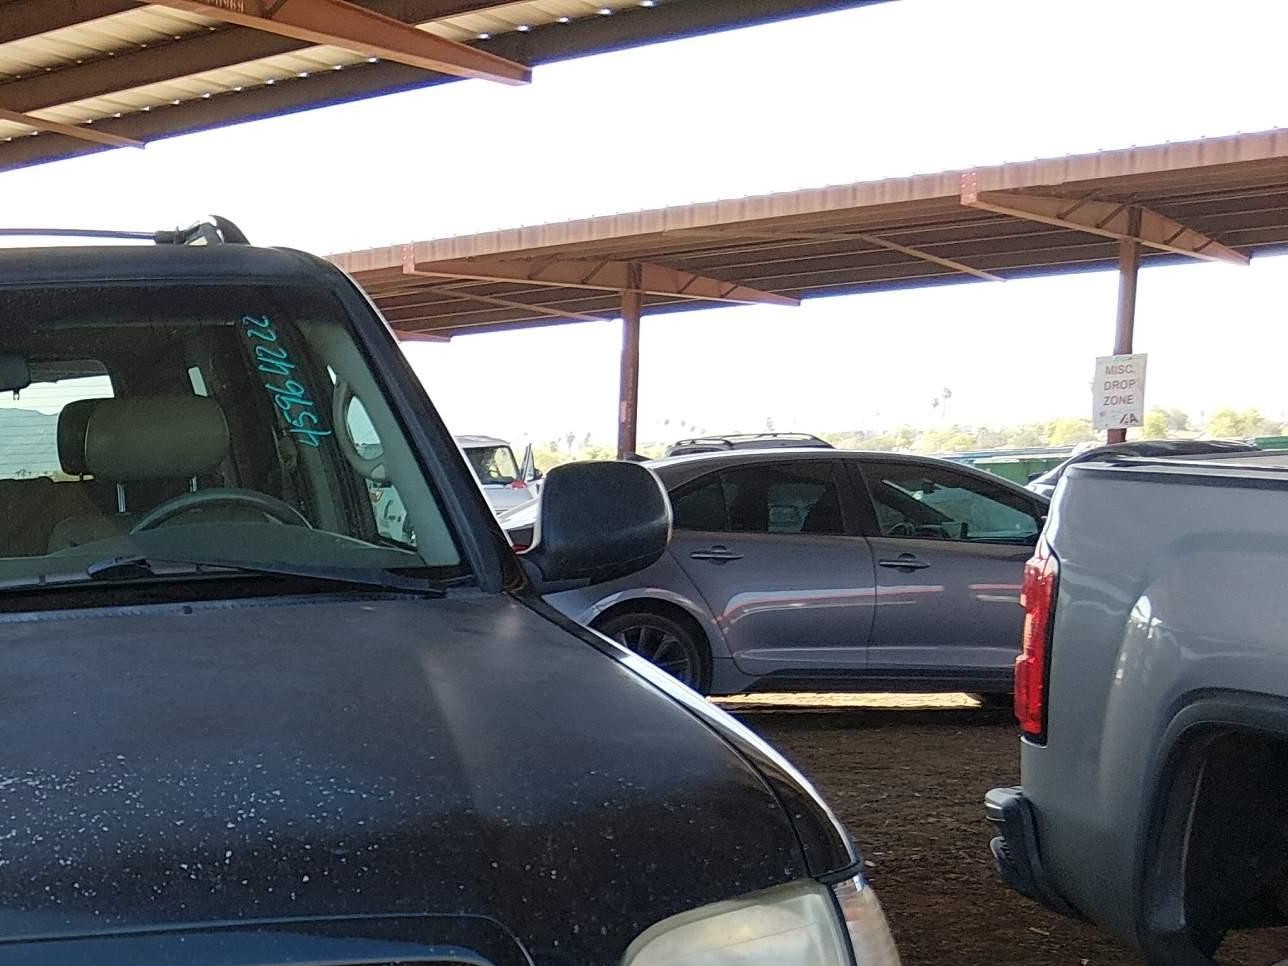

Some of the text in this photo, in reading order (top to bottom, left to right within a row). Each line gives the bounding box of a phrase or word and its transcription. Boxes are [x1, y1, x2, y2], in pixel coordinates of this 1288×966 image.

[242, 315, 332, 447] 45964222
[1103, 379, 1136, 391] DROP
[1103, 395, 1135, 406] ZONE
